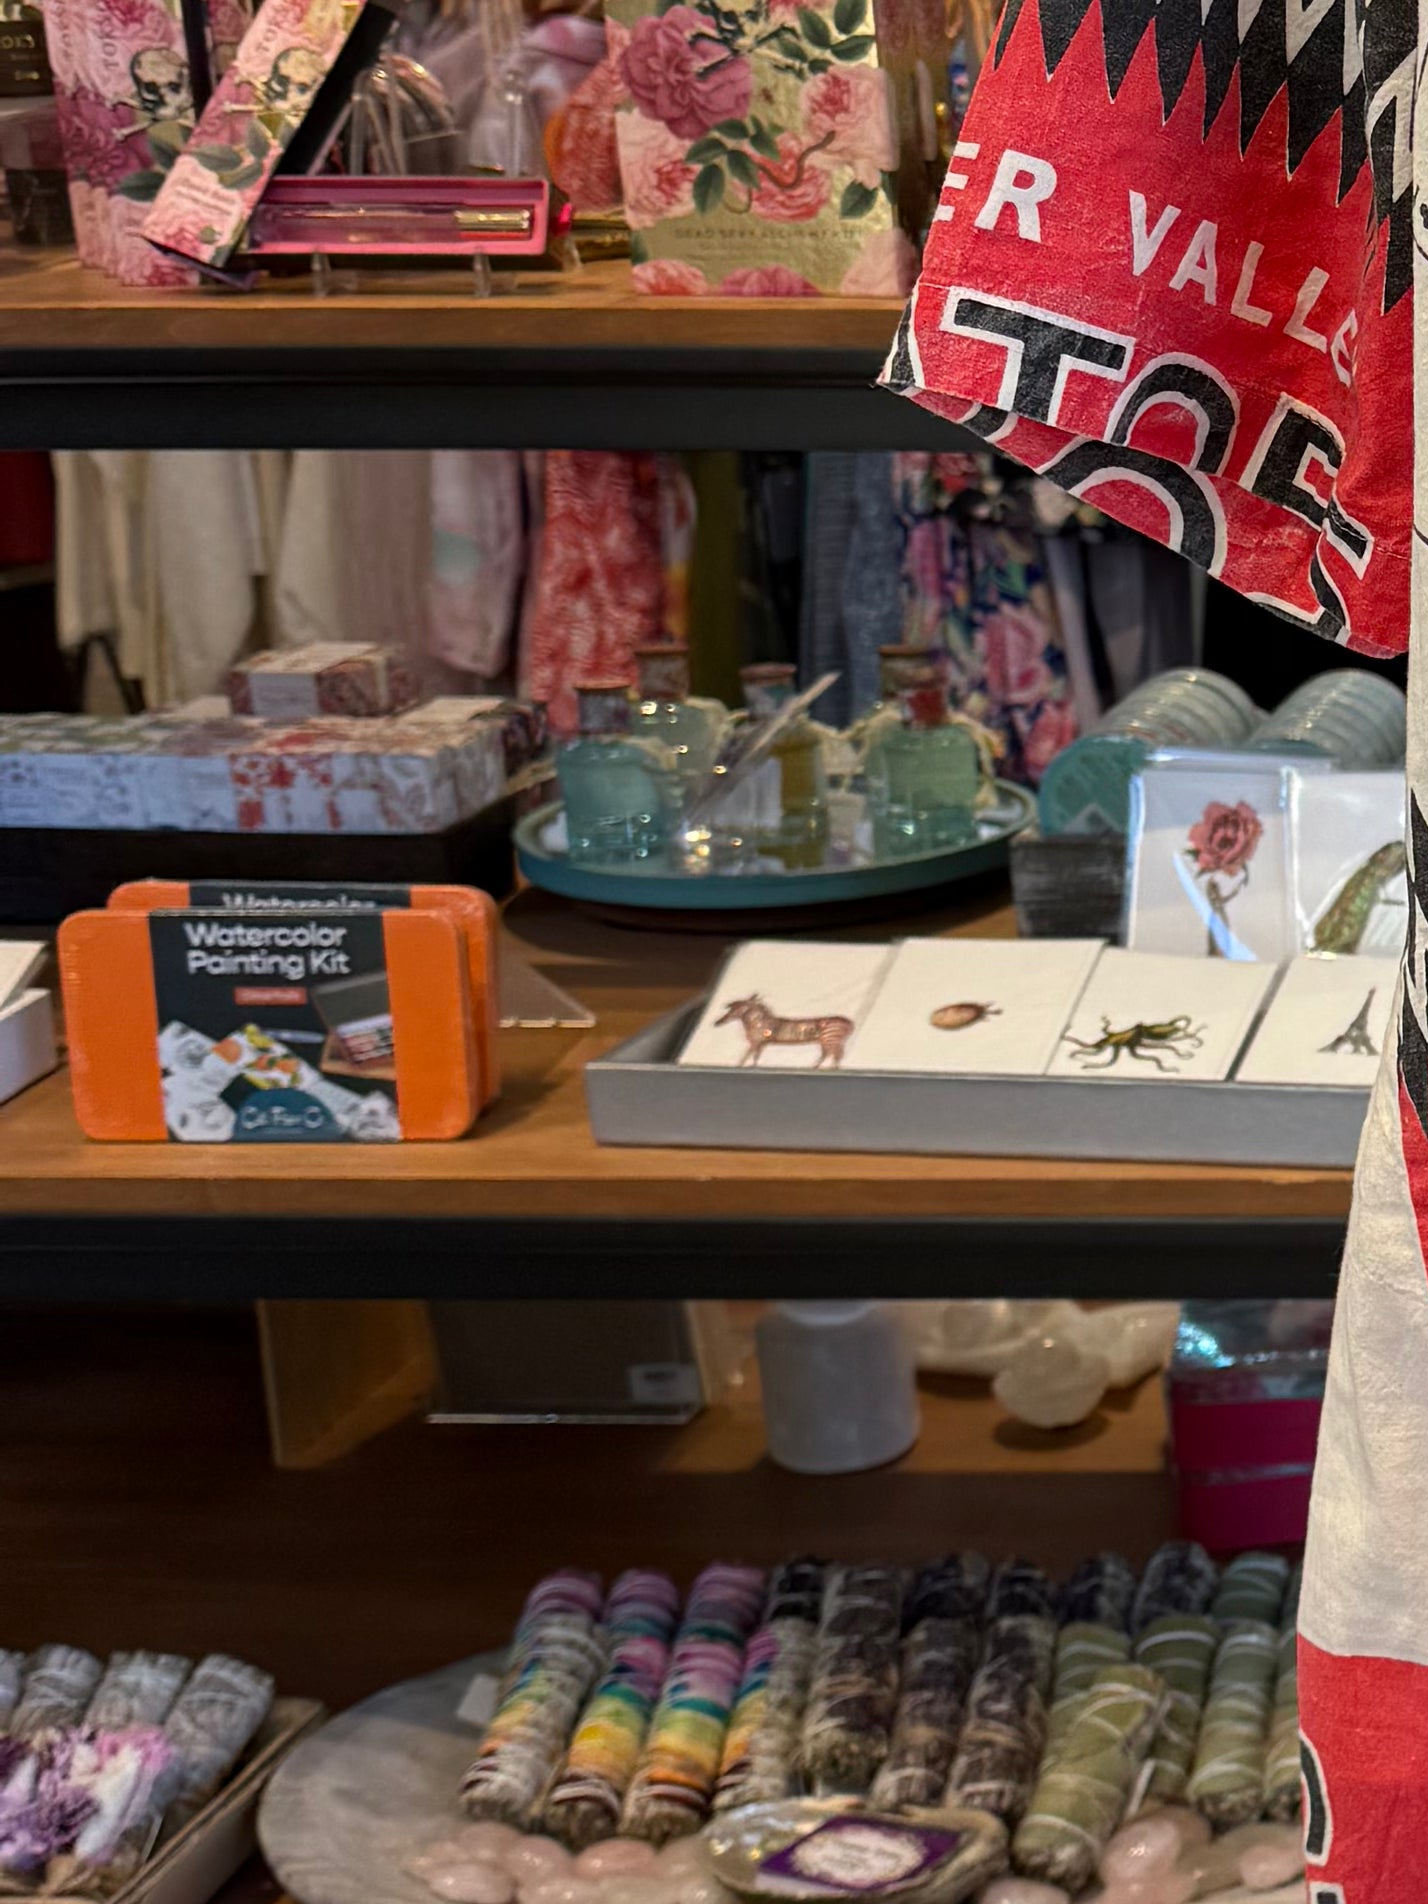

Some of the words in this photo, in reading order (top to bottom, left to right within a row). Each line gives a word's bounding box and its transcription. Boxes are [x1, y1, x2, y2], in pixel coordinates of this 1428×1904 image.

[183, 921, 348, 948] Watercolor
[187, 949, 306, 981] Painting
[309, 949, 352, 975] Kit
